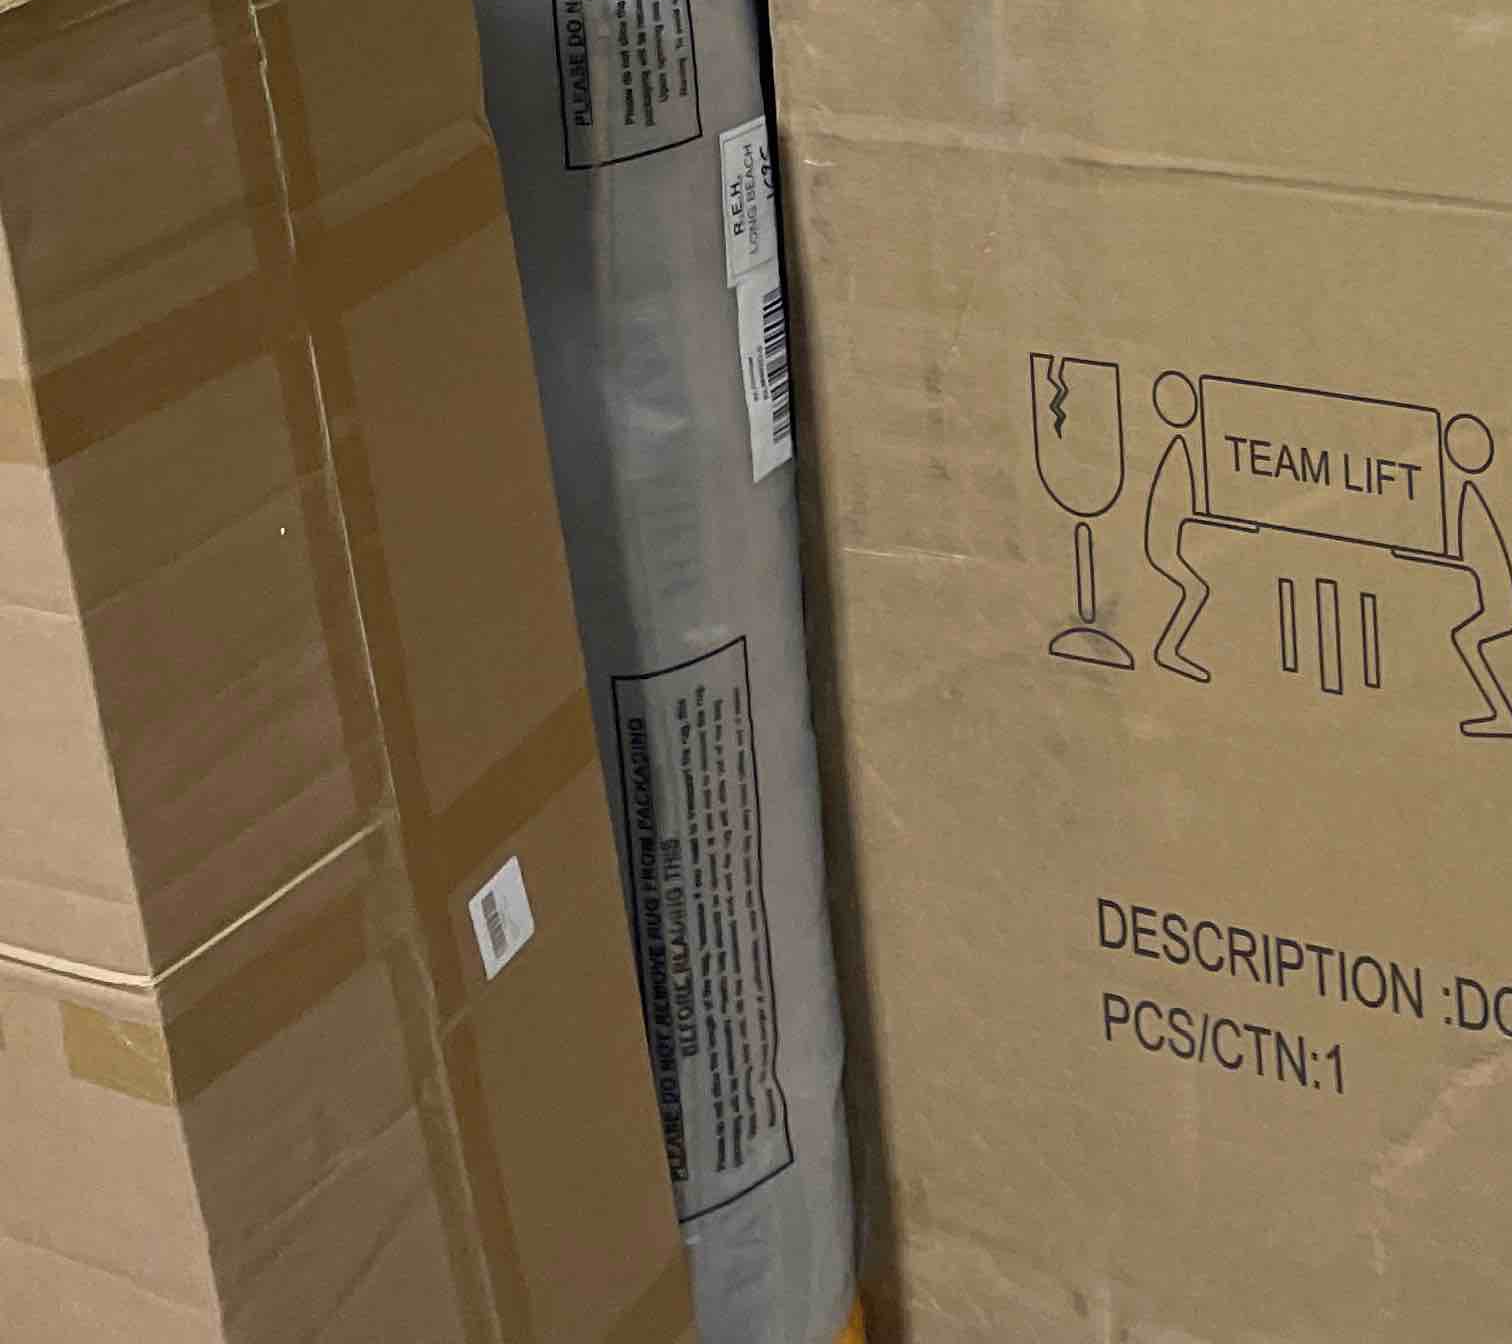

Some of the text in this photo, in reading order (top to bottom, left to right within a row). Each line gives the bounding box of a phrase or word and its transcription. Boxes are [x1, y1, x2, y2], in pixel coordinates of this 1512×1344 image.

[566, 19, 585, 47] DO
[569, 55, 591, 126] PLEASE
[730, 175, 743, 236] R.E.H.
[743, 144, 758, 255] LONG BEACH
[1225, 434, 1422, 501] TEAM LIFT
[1098, 897, 1424, 1019] DESCRIPTION
[1101, 992, 1346, 1094] PCS/CTN:1
